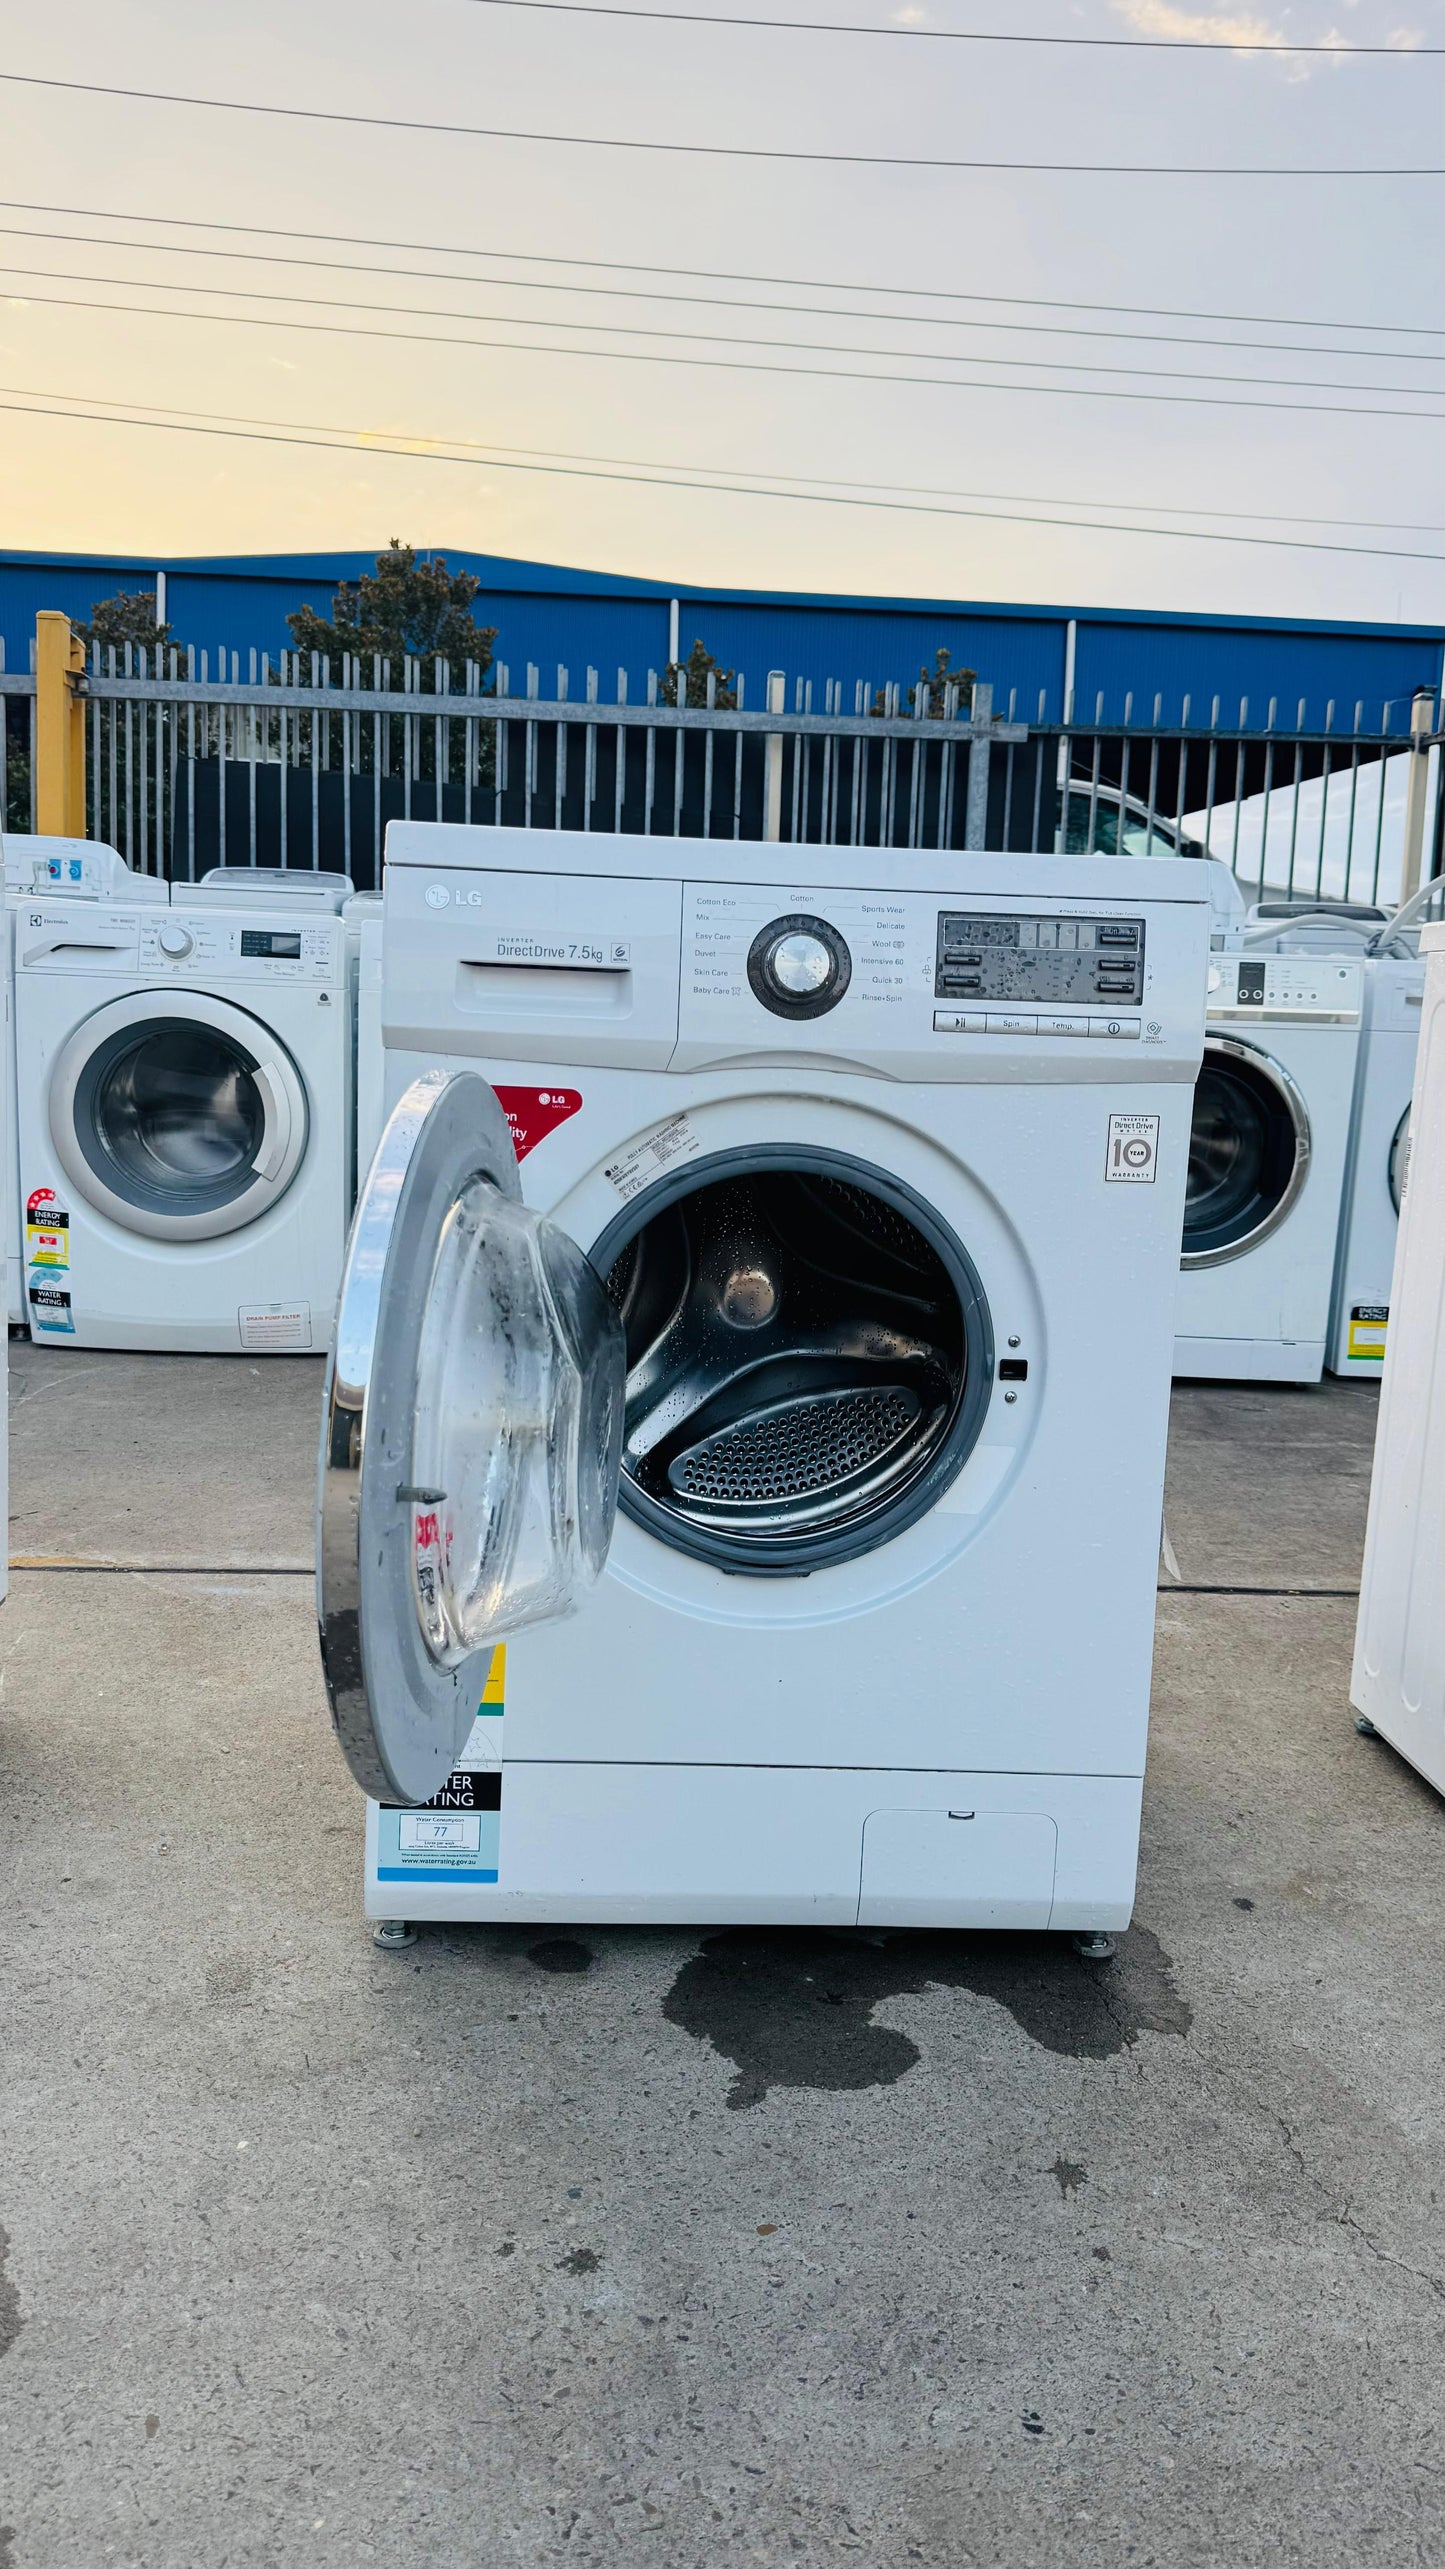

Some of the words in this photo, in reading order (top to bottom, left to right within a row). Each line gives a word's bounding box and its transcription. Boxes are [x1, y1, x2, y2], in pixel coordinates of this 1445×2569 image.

[455, 890, 482, 906] LG
[861, 905, 884, 913] Sports
[568, 945, 603, 962] 7.5kg
[693, 986, 711, 994] Baby
[1003, 1020, 1020, 1028] Spin
[1052, 1022, 1074, 1030] Temp.
[1114, 1139, 1152, 1168] 10
[35, 1211, 61, 1219] ENERGY
[444, 1776, 473, 1789] TER
[424, 1792, 474, 1806] TING
[434, 1827, 447, 1837] 77
